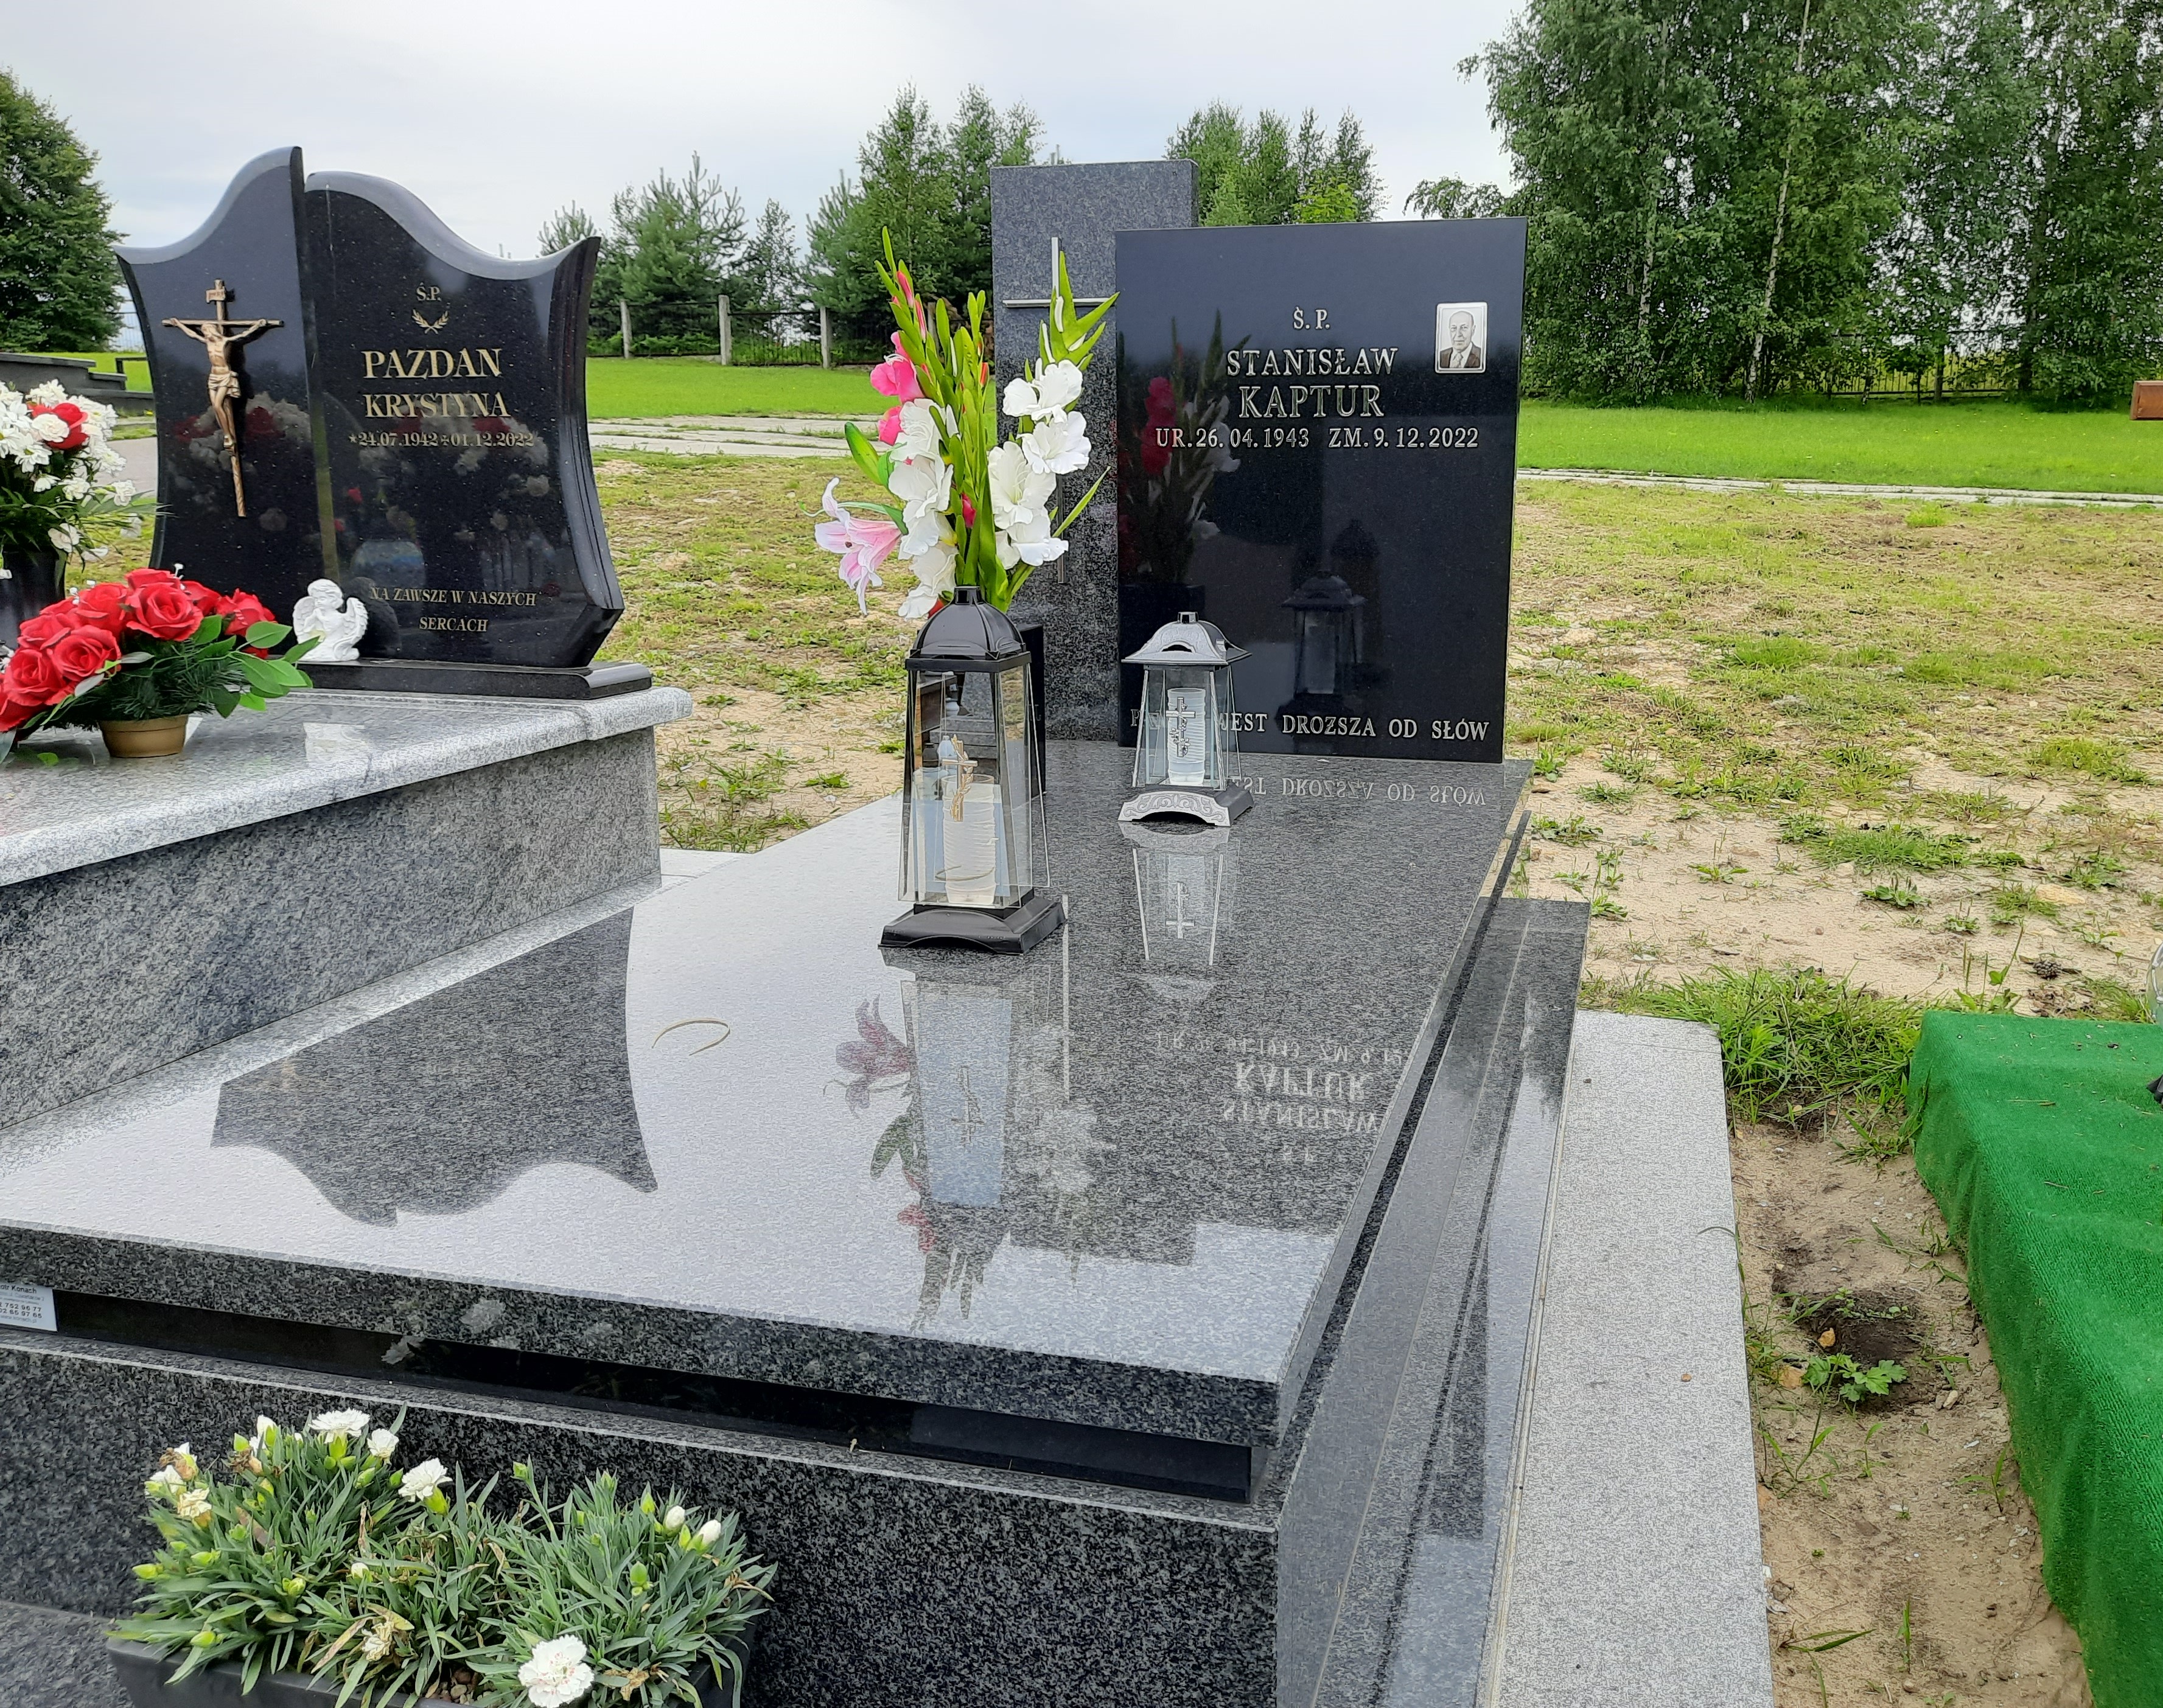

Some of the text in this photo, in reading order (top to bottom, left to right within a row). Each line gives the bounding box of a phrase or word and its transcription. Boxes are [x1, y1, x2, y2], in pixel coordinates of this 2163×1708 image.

[361, 347, 503, 380] PAZDAN
[1227, 347, 1399, 376] STANISŁAW
[363, 391, 511, 417] KRYSTYNA
[1239, 385, 1384, 418] KAPTUR
[370, 587, 537, 607] NA ZAWSZE W NASZYCH
[419, 616, 489, 632] SERCACH
[1388, 719, 1418, 738] OD
[1432, 717, 1490, 741] SŁÓW
